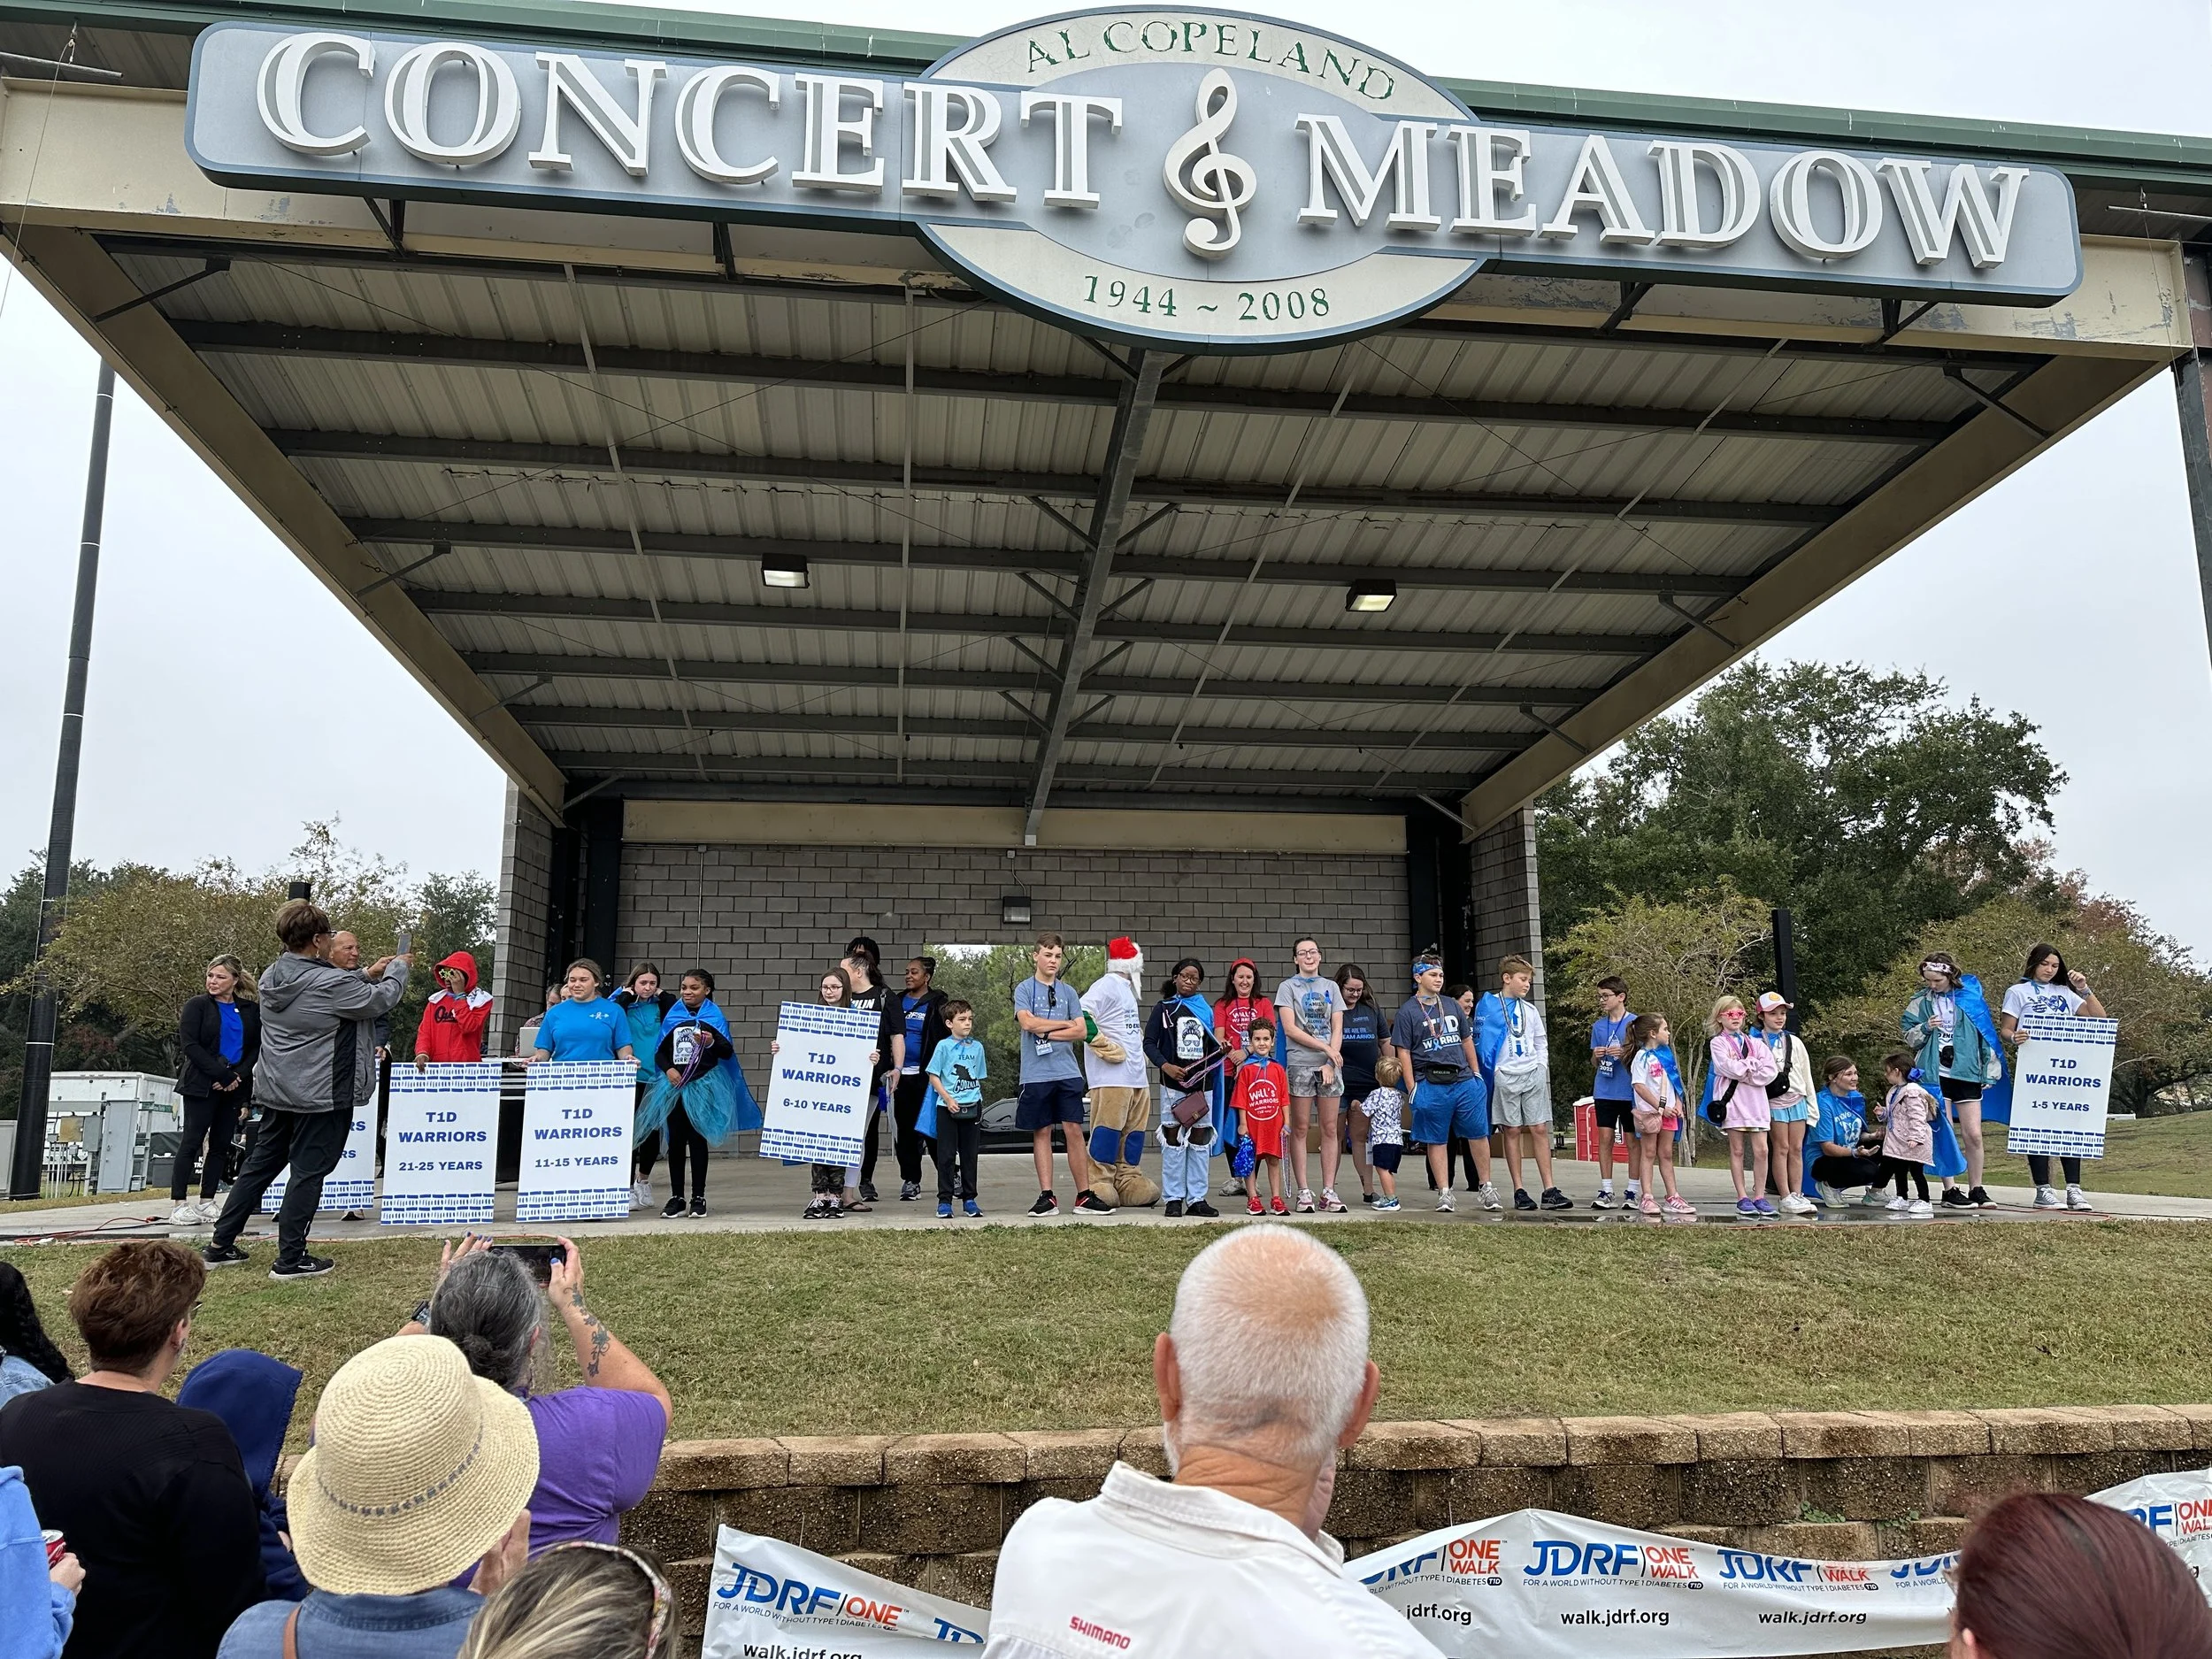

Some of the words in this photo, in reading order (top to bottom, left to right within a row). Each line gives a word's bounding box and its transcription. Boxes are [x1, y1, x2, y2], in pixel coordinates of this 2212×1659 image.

[1028, 27, 1091, 73] AL
[1102, 19, 1395, 100] COPELAND
[257, 32, 1122, 209] CONCERT
[1295, 113, 2031, 269] MEADOW
[1084, 275, 1177, 317] 1944
[1238, 288, 1330, 320] 2008
[808, 1052, 836, 1065] T1D
[2049, 1058, 2078, 1069] T1D
[782, 1068, 861, 1087] WARRIORS
[2025, 1073, 2101, 1087] WARRIORS
[783, 1098, 808, 1110] 6-10
[811, 1101, 852, 1114] YEARS
[1248, 1098, 1279, 1107] WARRIORS
[2032, 1101, 2048, 1110] 1-5
[2052, 1102, 2090, 1111] YEARS
[426, 1111, 457, 1123] T1D
[561, 1109, 593, 1120] T1D
[398, 1131, 488, 1143] WARRIORS
[534, 1126, 623, 1140] WARRIORS
[398, 1161, 435, 1171] 21-25
[438, 1160, 483, 1171] YEARS
[534, 1157, 571, 1168] 11-15
[575, 1156, 618, 1166] YEARS
[2178, 1499, 2212, 1520] ON
[2181, 1517, 2212, 1535] WAL
[2179, 1533, 2210, 1545] DIABETES
[1448, 1540, 1502, 1560] ONE
[1523, 1540, 1638, 1577] JDRF
[1646, 1546, 1694, 1565] ONE
[1449, 1559, 1500, 1575] WALK
[1650, 1564, 1700, 1579] WALK
[1823, 1569, 1870, 1582] WALK
[1919, 1577, 1947, 1586] WORLD
[1385, 1577, 1419, 1591] WITHOUT
[1446, 1576, 1486, 1586] DIABETES
[1487, 1577, 1502, 1586] T1D
[1646, 1580, 1687, 1589] DIABETES
[1688, 1581, 1704, 1590] T1D
[716, 1562, 841, 1616] JDRF
[846, 1596, 903, 1627] ONE
[713, 1601, 732, 1611] FOR
[733, 1603, 739, 1612] A
[741, 1605, 772, 1618] WORLD
[772, 1612, 810, 1624] WITHOUT
[814, 1617, 834, 1625] TYPE
[841, 1620, 883, 1629] DIABETES
[1405, 1603, 1472, 1625] jdrf.org
[1561, 1609, 1670, 1626] walk.jdrf.org
[1758, 1610, 1867, 1625] walk.jdrf.org
[1069, 1616, 1131, 1650] SHIMANO
